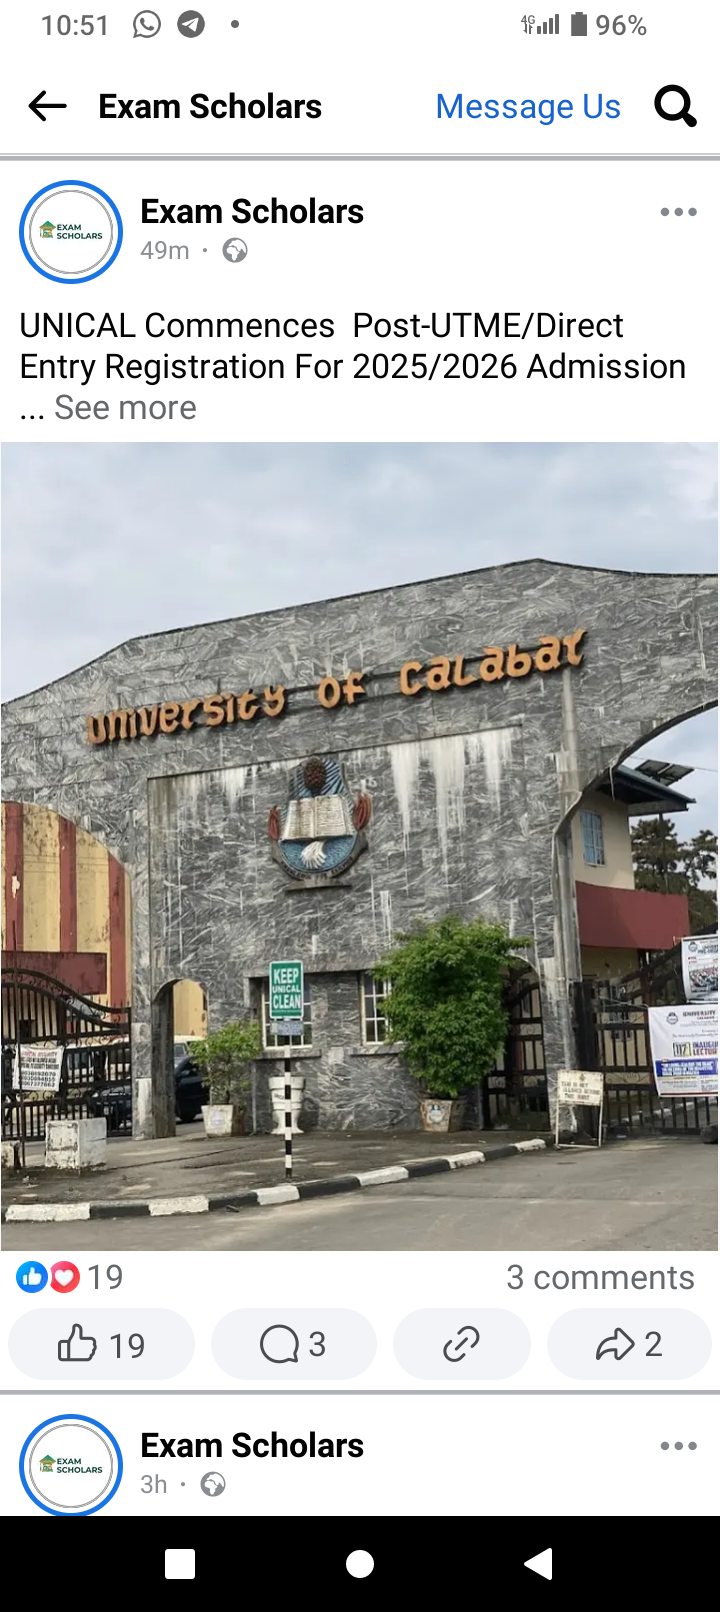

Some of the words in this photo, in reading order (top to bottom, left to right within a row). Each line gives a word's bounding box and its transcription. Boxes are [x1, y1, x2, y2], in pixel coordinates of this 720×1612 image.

[42, 15, 106, 35] 10:51
[521, 14, 536, 25] 4G
[596, 15, 647, 35] 96%
[100, 93, 180, 119] Exam
[190, 92, 322, 119] Scholars
[437, 94, 573, 125] Message
[584, 94, 620, 119] Us
[142, 198, 222, 224] Exam
[232, 197, 364, 224] Scholars
[57, 232, 103, 240] SCHOLARS
[141, 241, 188, 259] 49m
[21, 312, 136, 338] UNICAL
[146, 312, 334, 338] Commences
[354, 312, 623, 339] Post-UTME/Direct
[21, 353, 96, 386] Entry
[106, 353, 284, 385] Registration
[296, 353, 343, 379] For
[353, 353, 517, 380] 2025/2026
[526, 352, 685, 379] Admission
[55, 394, 109, 420] See
[120, 400, 196, 420] more
[273, 968, 300, 985] KEEP
[273, 984, 301, 993] UNICAL
[273, 994, 301, 1009] CLEAN
[89, 1264, 122, 1290] 19
[507, 1264, 523, 1290] 3
[534, 1266, 694, 1290] comments
[111, 1333, 144, 1358] 19
[309, 1331, 325, 1357] 3
[645, 1331, 662, 1356] 2
[142, 1432, 222, 1458] Exam
[232, 1431, 364, 1458] Scholars
[57, 1466, 103, 1474] SCHOLARS
[141, 1474, 166, 1493] 3h
